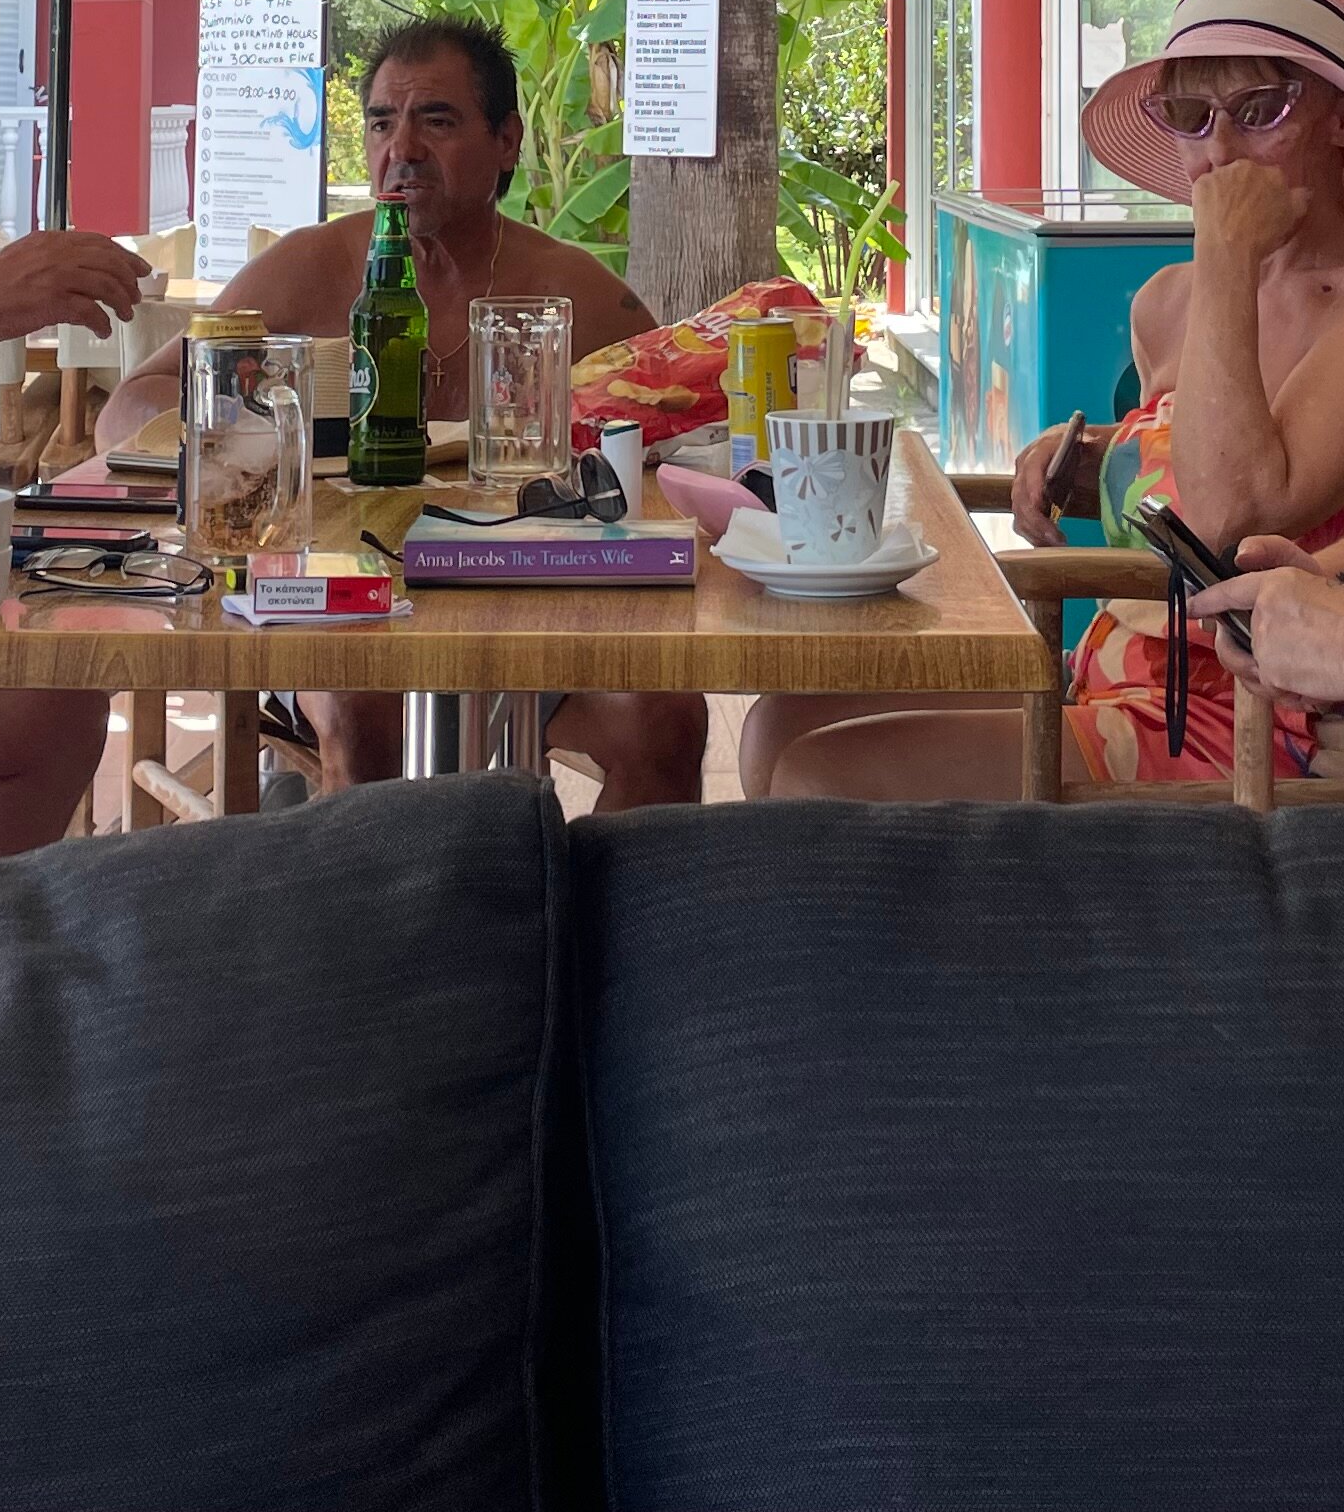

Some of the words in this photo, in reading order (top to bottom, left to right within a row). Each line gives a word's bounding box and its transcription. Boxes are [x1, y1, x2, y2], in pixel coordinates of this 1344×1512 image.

[263, 14, 300, 25] POOL
[200, 30, 226, 40] AFTER
[287, 29, 318, 39] HOURS
[201, 42, 226, 52] WILL
[234, 42, 247, 50] BE
[200, 55, 223, 65] WITH
[290, 52, 315, 63] FINE
[203, 73, 219, 82] POOL
[221, 73, 237, 82] INFO
[415, 552, 454, 567] Anna
[458, 551, 505, 568] Jacobs
[509, 550, 536, 566] The
[541, 550, 597, 566] Trader's
[601, 549, 634, 565] Wife
[260, 584, 272, 593] Το
[268, 597, 314, 605] σκοτώνει
